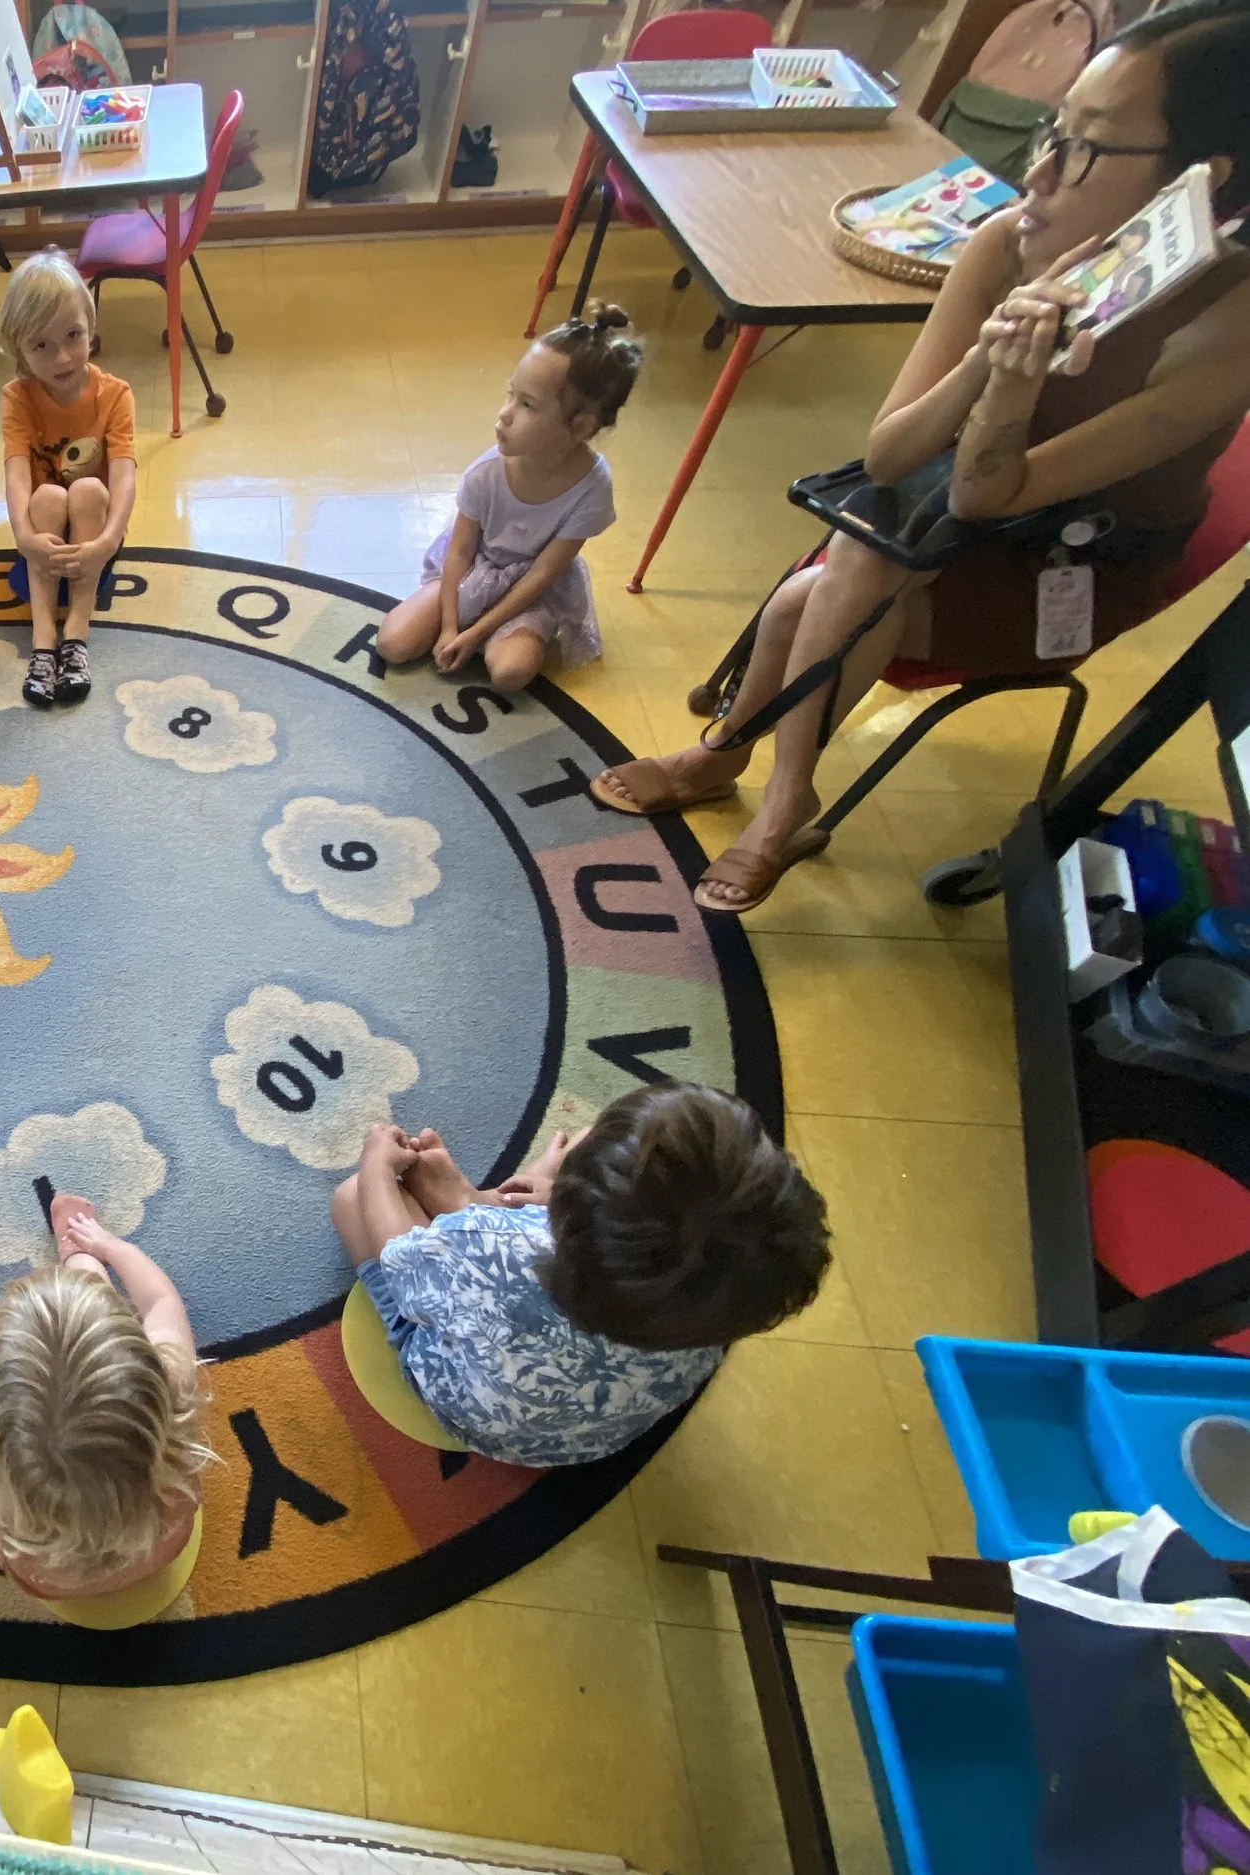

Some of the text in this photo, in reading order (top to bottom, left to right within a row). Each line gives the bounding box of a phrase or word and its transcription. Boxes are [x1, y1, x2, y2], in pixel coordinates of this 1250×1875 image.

[94, 574, 148, 612] P
[217, 585, 290, 639] Q
[168, 706, 211, 739] 8
[432, 686, 514, 735] S
[516, 757, 606, 812] T
[321, 841, 378, 872] 9
[573, 864, 680, 933] U
[256, 1034, 344, 1114] 10
[586, 1025, 692, 1086] V
[228, 1408, 349, 1560] Y
